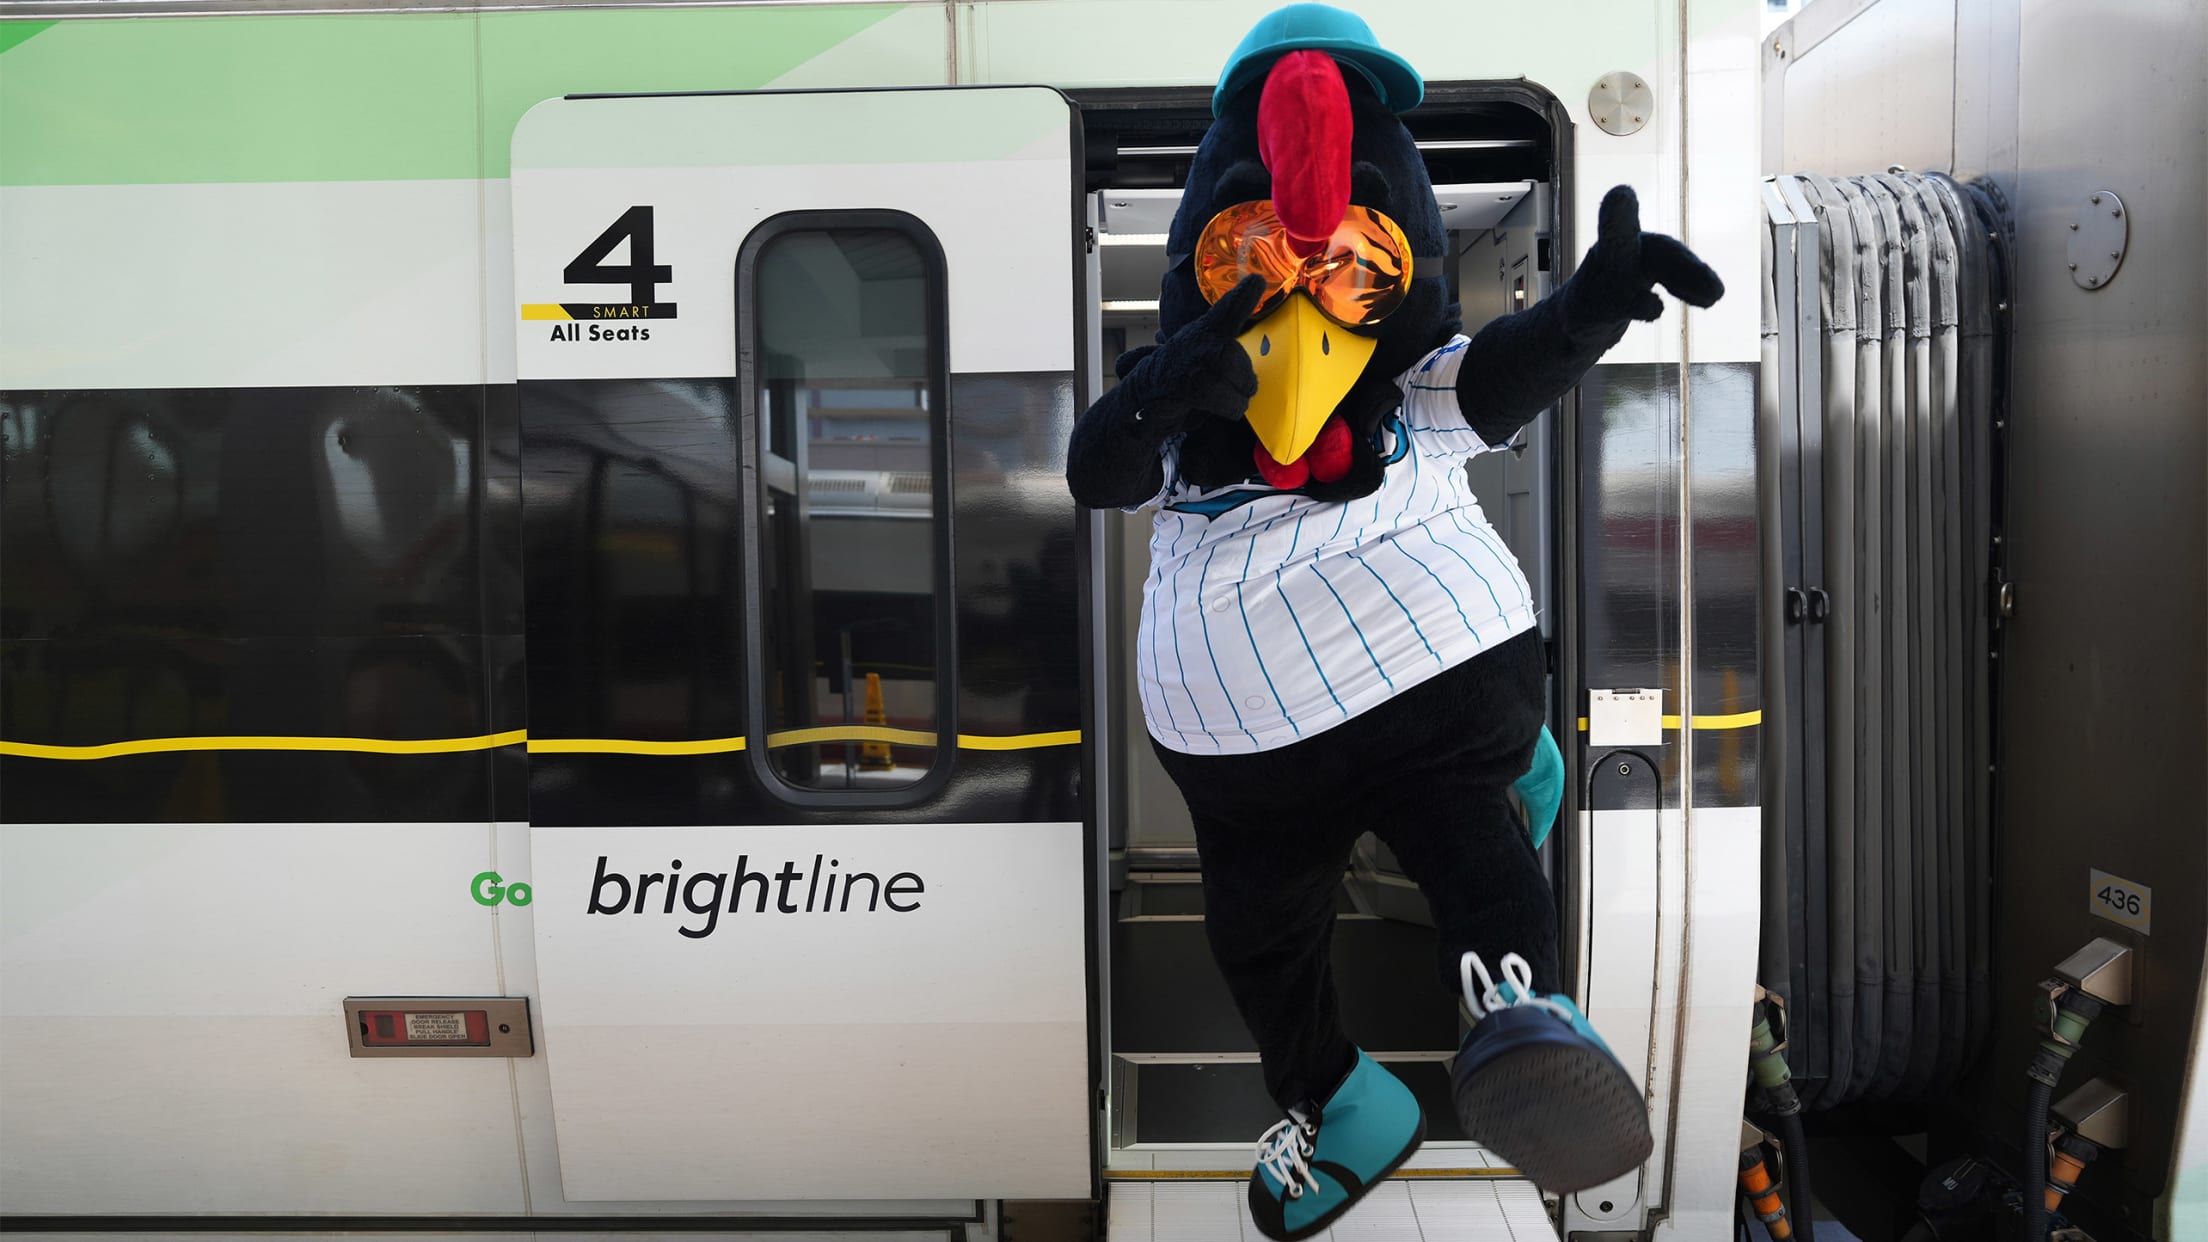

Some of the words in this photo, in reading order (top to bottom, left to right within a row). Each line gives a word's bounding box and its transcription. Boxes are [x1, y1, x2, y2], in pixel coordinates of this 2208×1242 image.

[563, 205, 673, 304] 4
[593, 306, 649, 318] SMART
[550, 323, 580, 342] All
[588, 324, 650, 342] Seats
[471, 871, 532, 907] Go
[587, 854, 925, 939] brightline
[2097, 886, 2140, 916] 436
